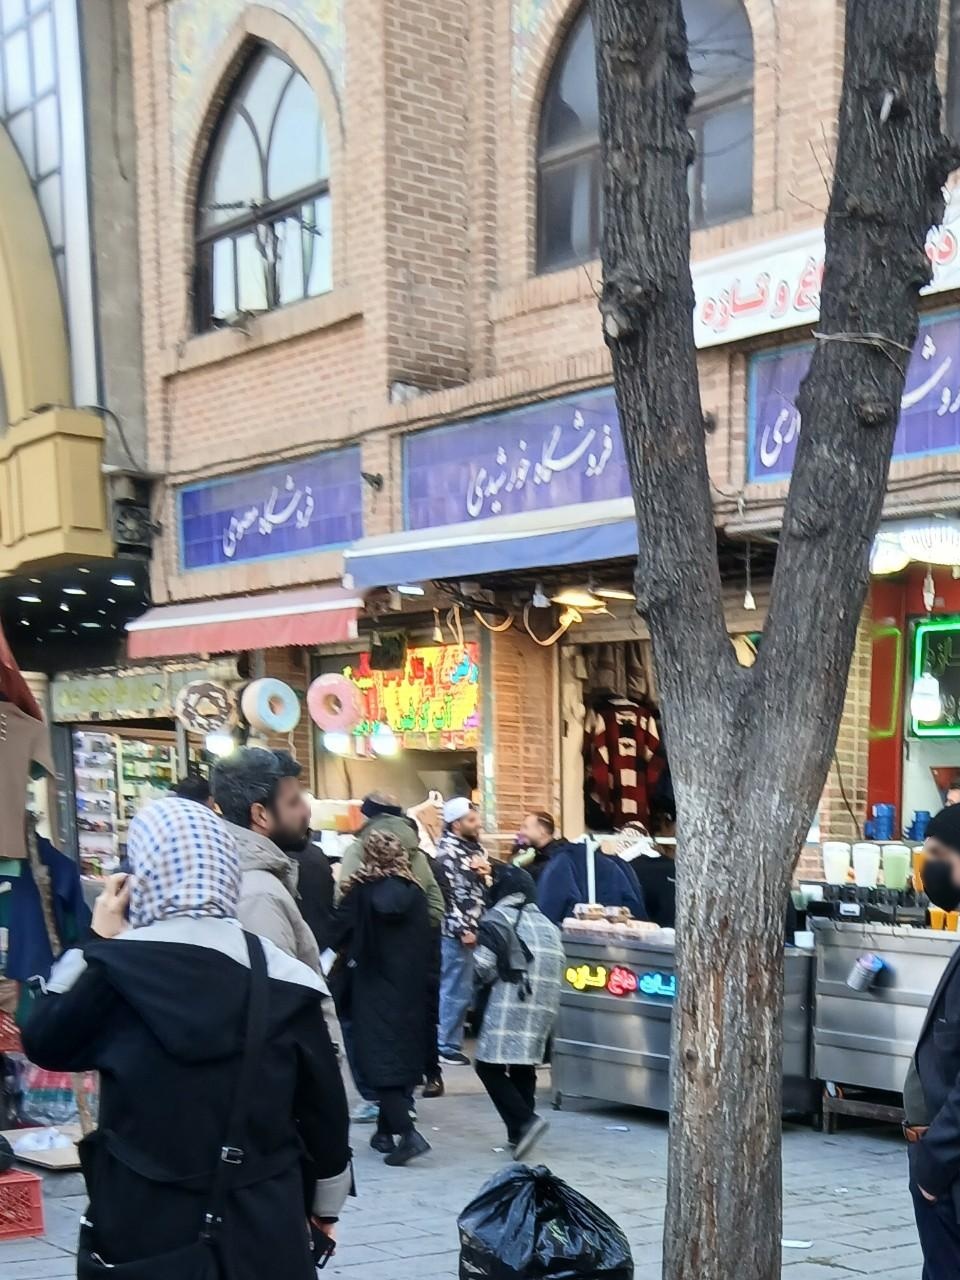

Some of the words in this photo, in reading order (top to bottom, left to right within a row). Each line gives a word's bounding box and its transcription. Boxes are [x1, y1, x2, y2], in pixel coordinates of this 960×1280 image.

[700, 271, 771, 334] تازه
[769, 279, 791, 319] و
[533, 409, 614, 486] فروشگاه
[258, 474, 314, 536] فروشگاه
[565, 964, 607, 990] تازه
